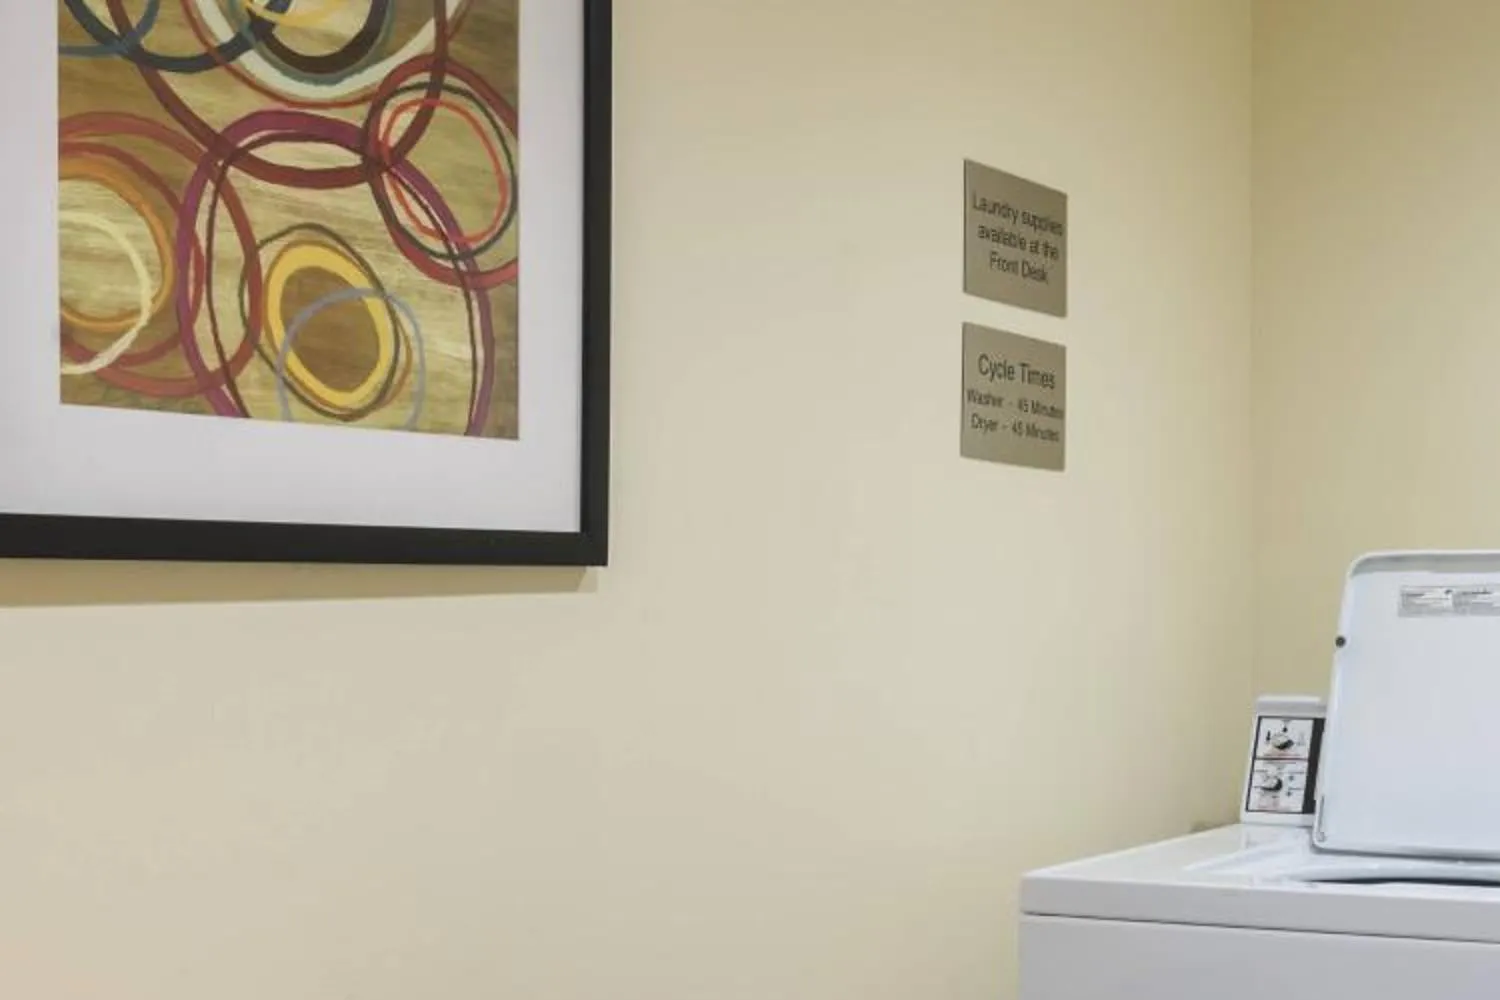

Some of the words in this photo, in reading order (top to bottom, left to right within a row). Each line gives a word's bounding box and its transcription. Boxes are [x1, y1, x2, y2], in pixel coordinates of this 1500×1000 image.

[972, 191, 1019, 225] Laundry
[1021, 210, 1063, 237] supplies
[978, 224, 1026, 251] available
[1029, 239, 1040, 254] at
[1042, 240, 1059, 261] the
[990, 250, 1019, 276] Front
[1021, 259, 1048, 284] Desk
[978, 353, 1015, 383] Cycle
[1019, 362, 1055, 390] Times
[967, 389, 1003, 408] Washer
[971, 412, 998, 434] Dryer
